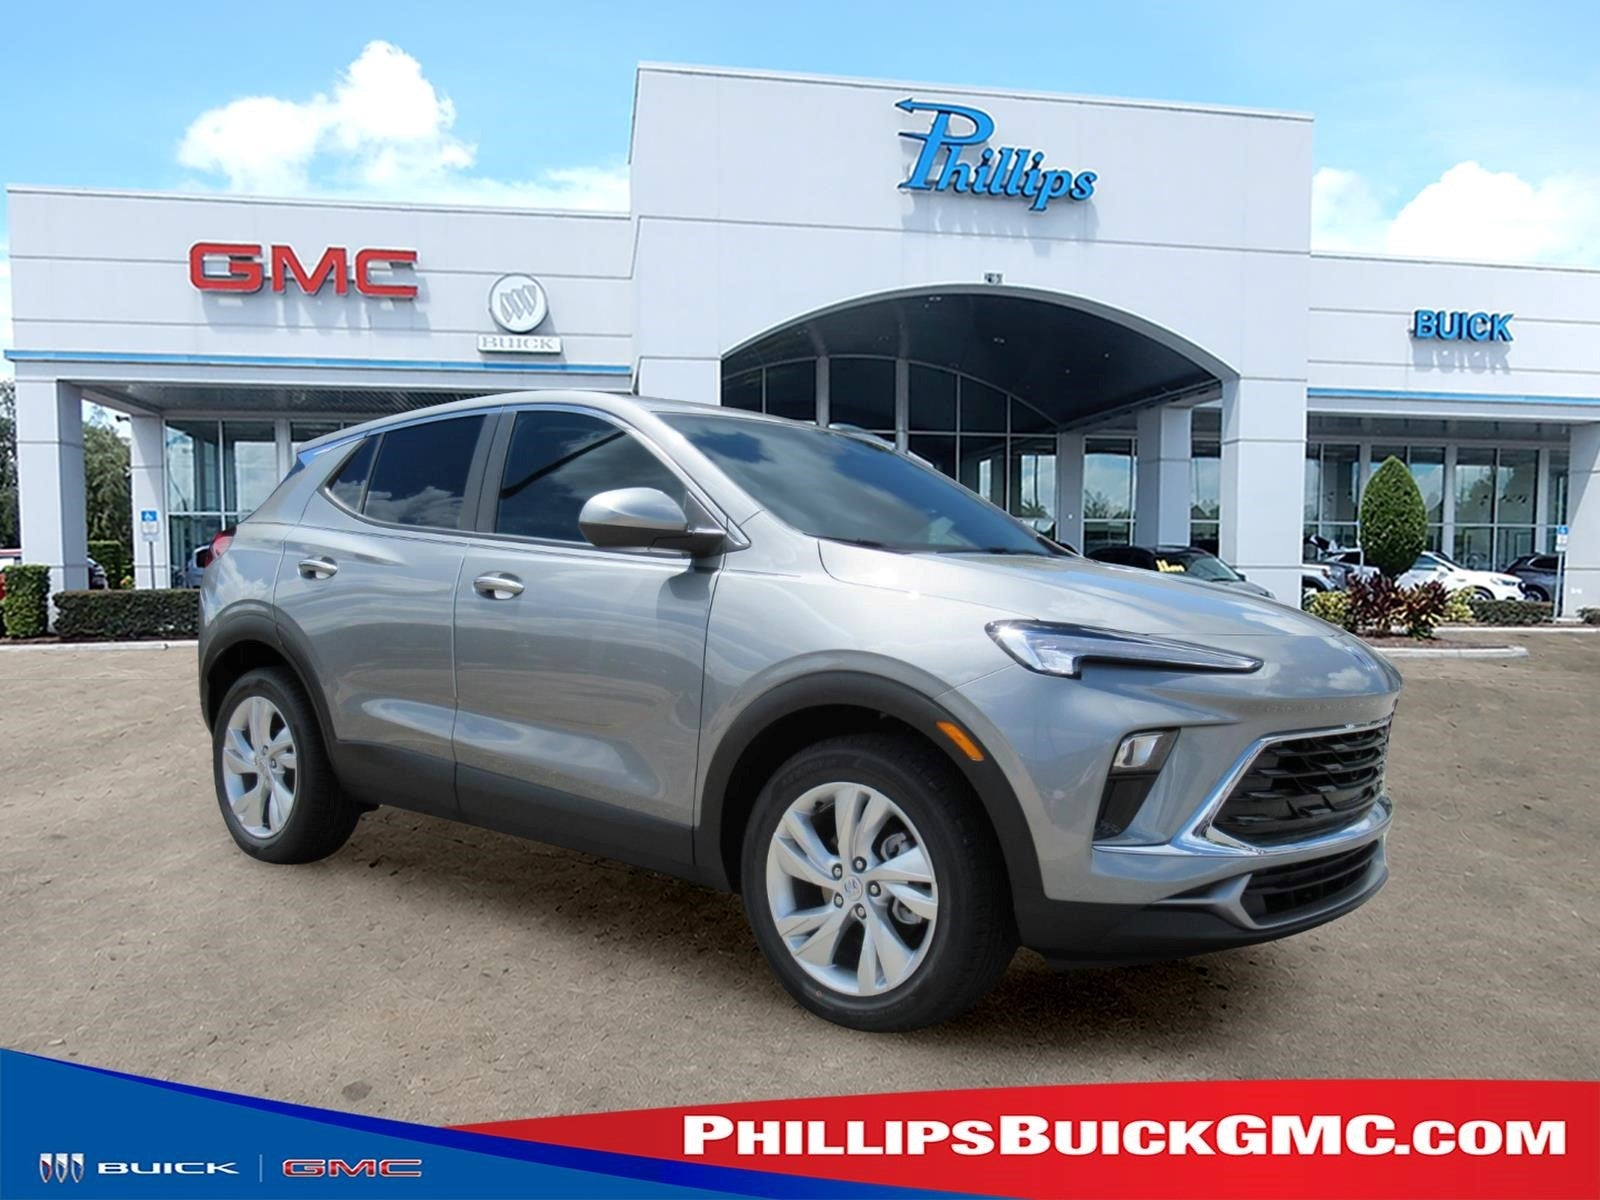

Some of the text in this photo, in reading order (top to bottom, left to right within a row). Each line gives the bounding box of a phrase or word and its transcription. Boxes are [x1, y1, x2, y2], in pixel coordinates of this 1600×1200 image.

[895, 98, 1098, 212] Phillips
[190, 242, 418, 298] GMC
[481, 336, 554, 349] BUICK
[1414, 309, 1514, 341] BUICK
